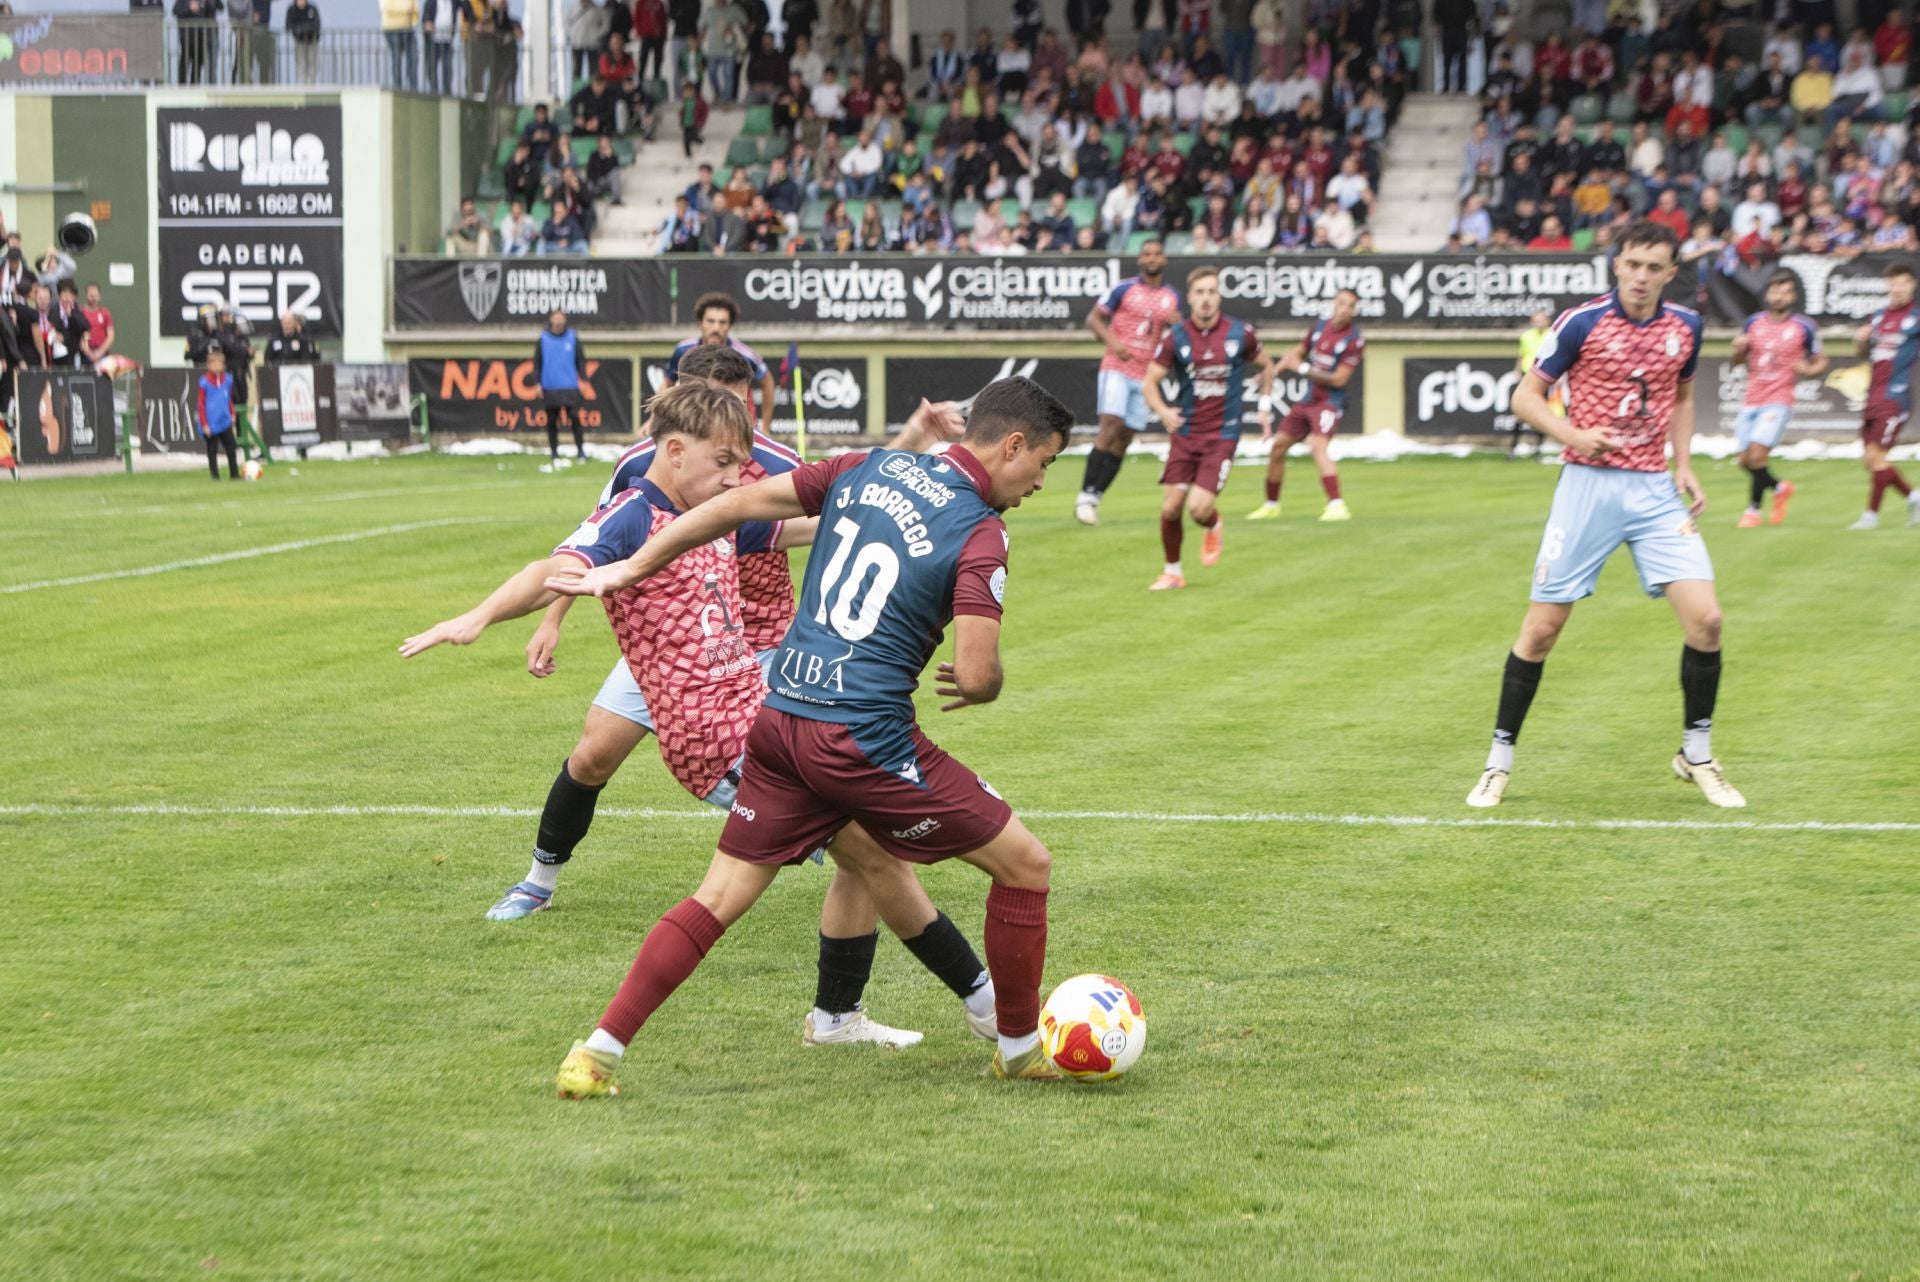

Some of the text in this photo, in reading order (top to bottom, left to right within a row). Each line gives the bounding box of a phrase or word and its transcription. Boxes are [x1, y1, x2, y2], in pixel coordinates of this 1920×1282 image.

[170, 121, 325, 172] Radio
[199, 243, 304, 266] CADENA
[507, 265, 607, 293] GIMNÁSTICA
[745, 258, 1120, 310] cajaviva cajarural
[1427, 255, 1611, 297] cajarural
[181, 270, 323, 321] SER
[507, 291, 598, 314] SEGOVIANA
[817, 296, 907, 322] Segovia
[949, 297, 1070, 318] Fundación
[1291, 297, 1386, 320] Segia
[440, 360, 600, 400] NACX
[1418, 362, 1522, 421] fibr
[495, 406, 602, 431] by Loita
[897, 472, 948, 508] PALOMO
[836, 483, 934, 558] J. BORREGO
[814, 516, 900, 641] 10
